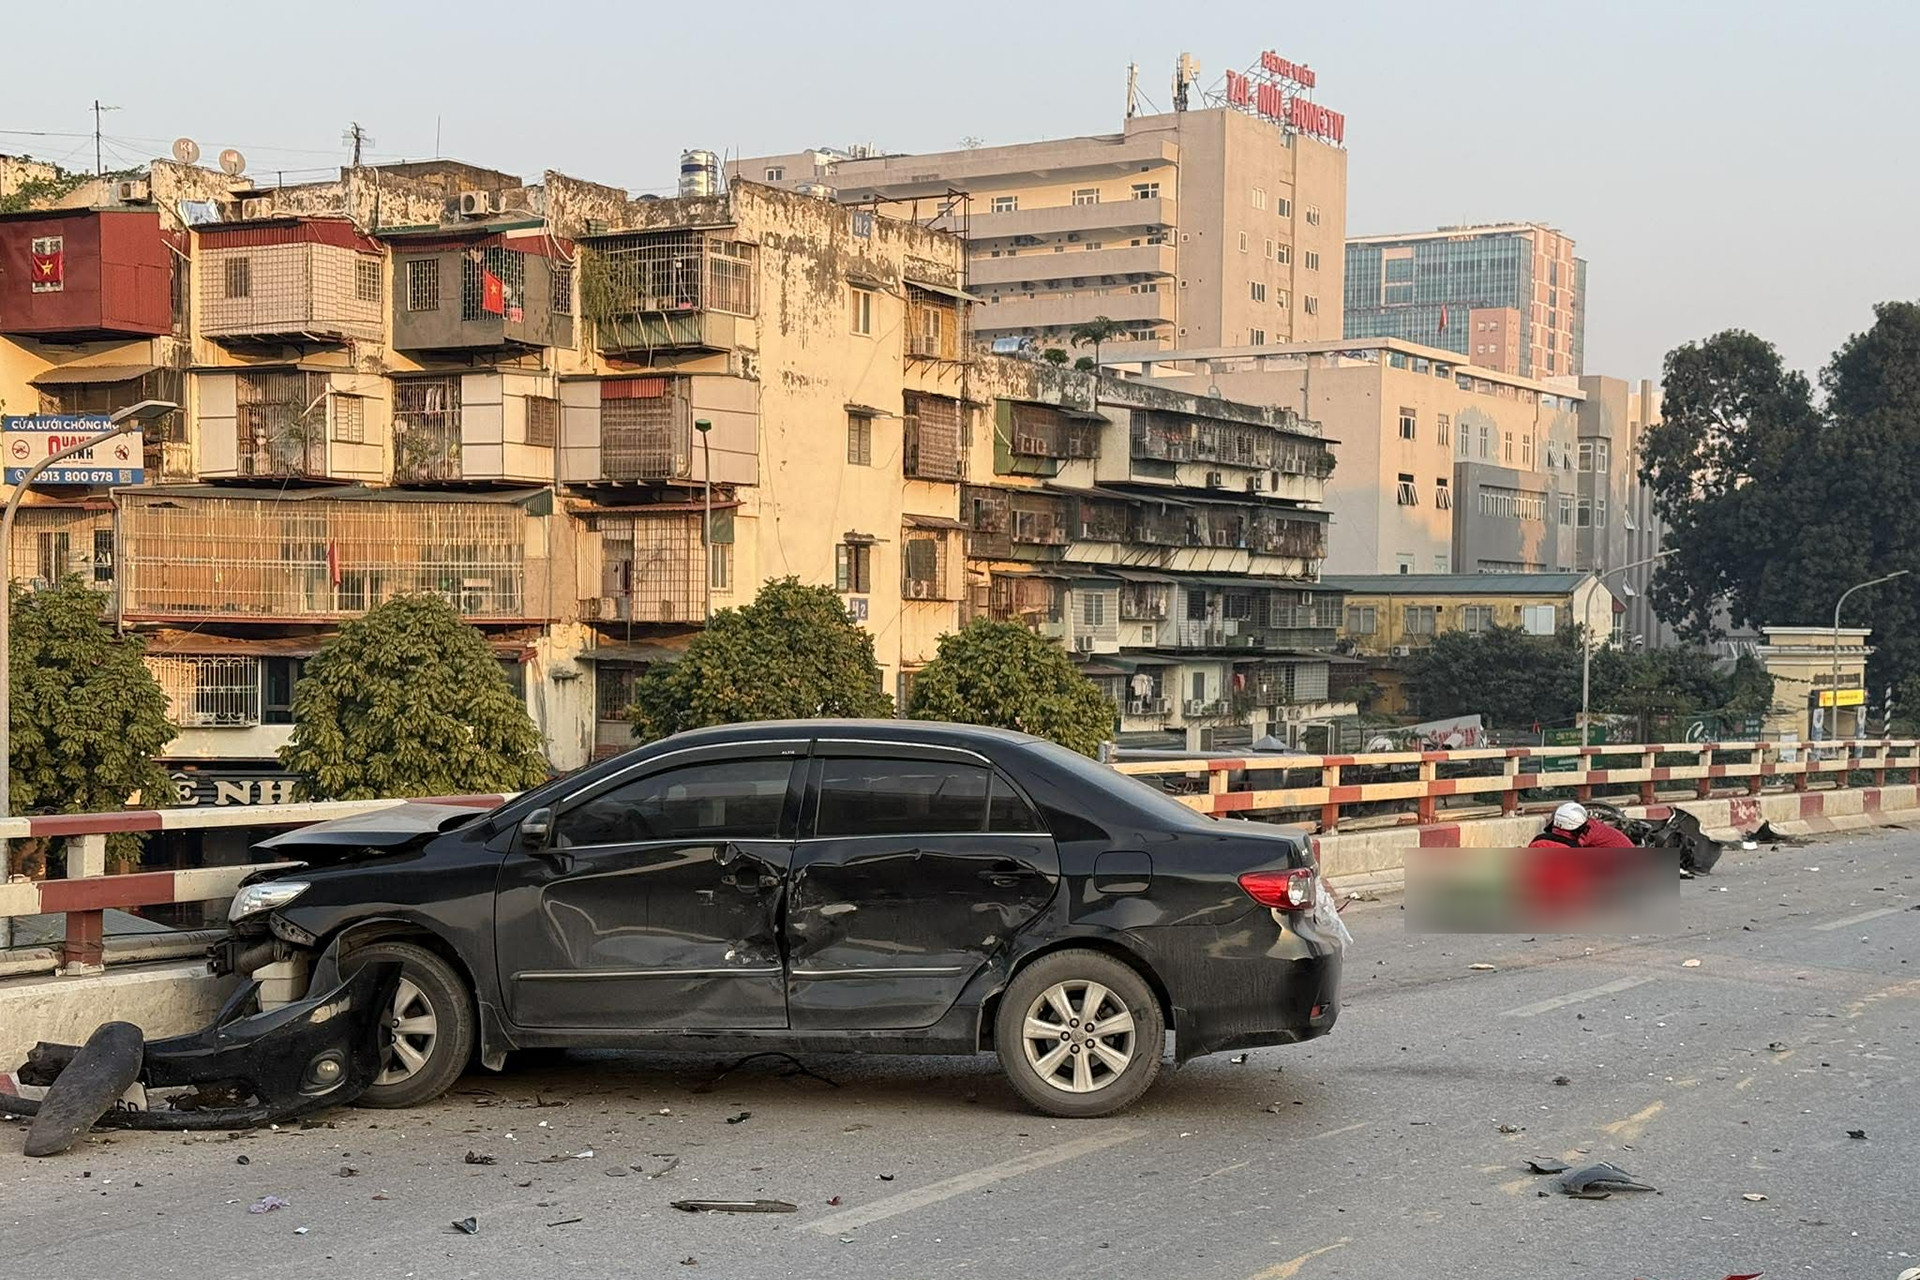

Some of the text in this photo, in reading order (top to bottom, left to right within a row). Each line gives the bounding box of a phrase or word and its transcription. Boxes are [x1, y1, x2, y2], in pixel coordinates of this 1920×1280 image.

[11, 418, 35, 429] CỬA
[36, 418, 61, 429] LƯỚI
[63, 417, 101, 430] CHỐNG
[65, 471, 89, 481] 800
[91, 471, 113, 481] 678
